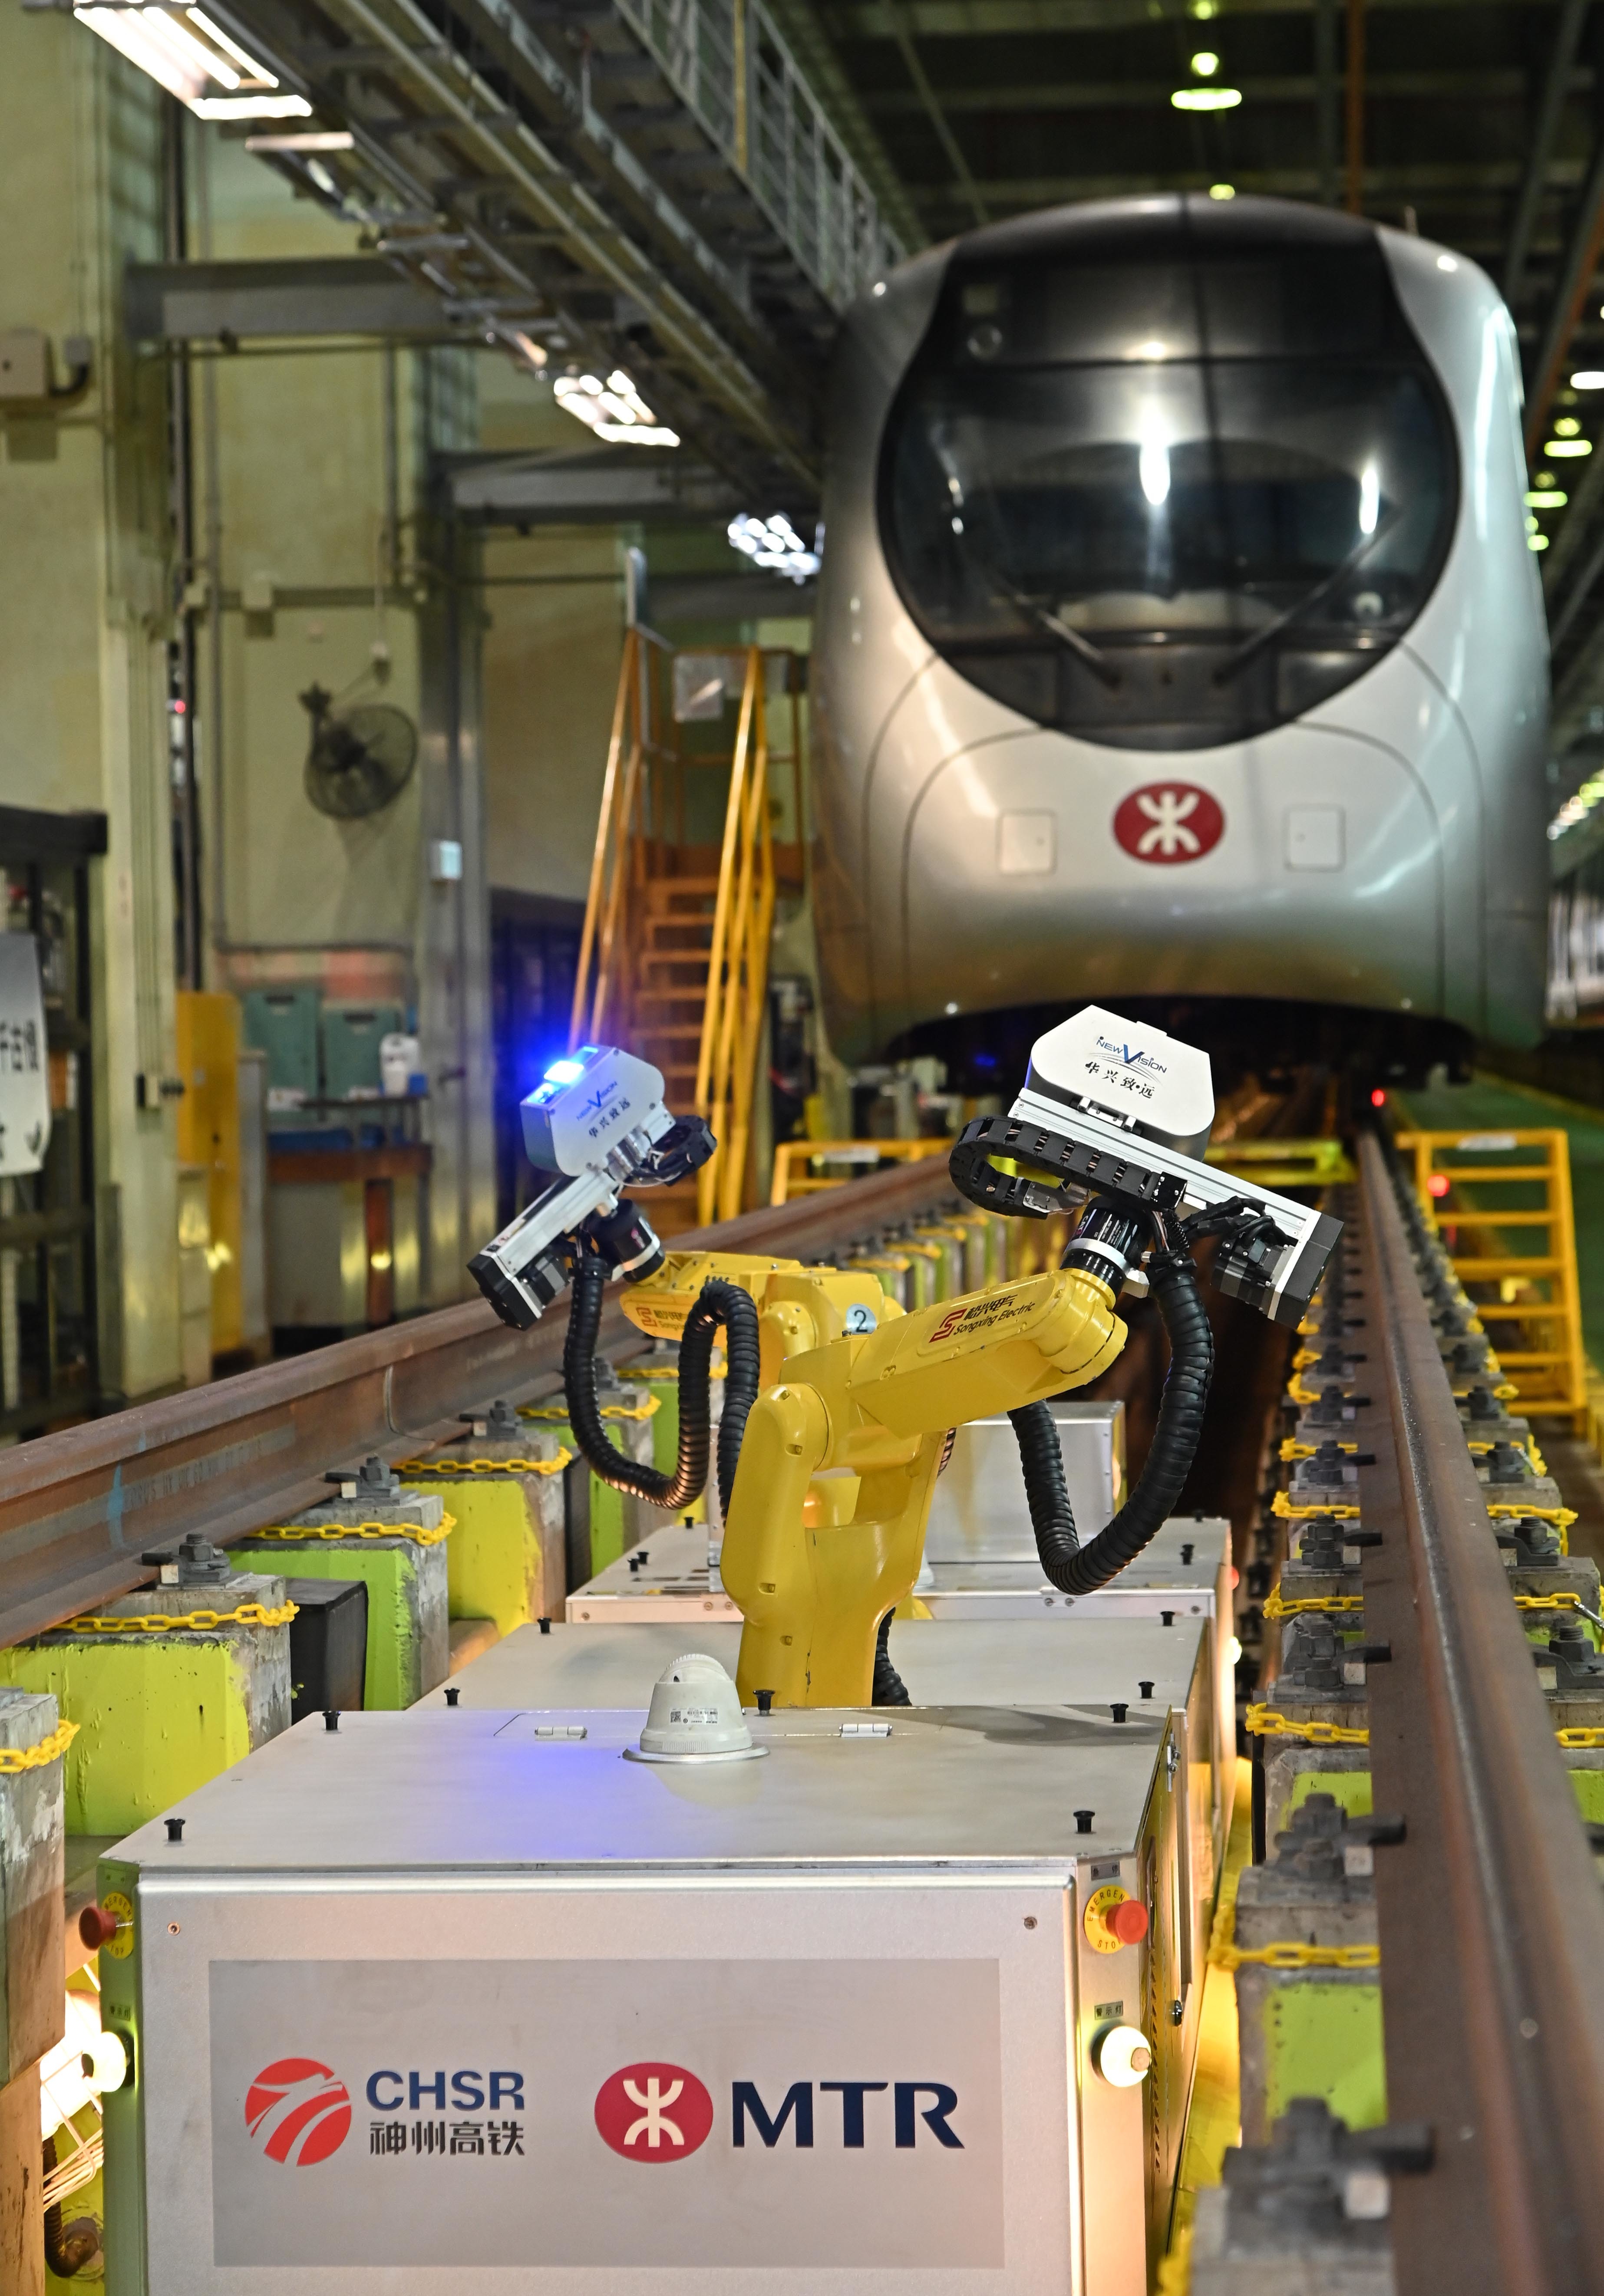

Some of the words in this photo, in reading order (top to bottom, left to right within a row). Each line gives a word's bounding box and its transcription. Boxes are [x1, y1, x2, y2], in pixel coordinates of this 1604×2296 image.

[854, 1310, 868, 1333] 2
[953, 1315, 999, 1335] Songxing
[997, 1301, 1036, 1321] Electric
[1087, 1889, 1125, 1922] EMERGEN
[1098, 1940, 1120, 1950] STO
[366, 2070, 525, 2112] CHSR
[732, 2082, 965, 2149] MTR
[370, 2120, 525, 2156] 神州高铁
